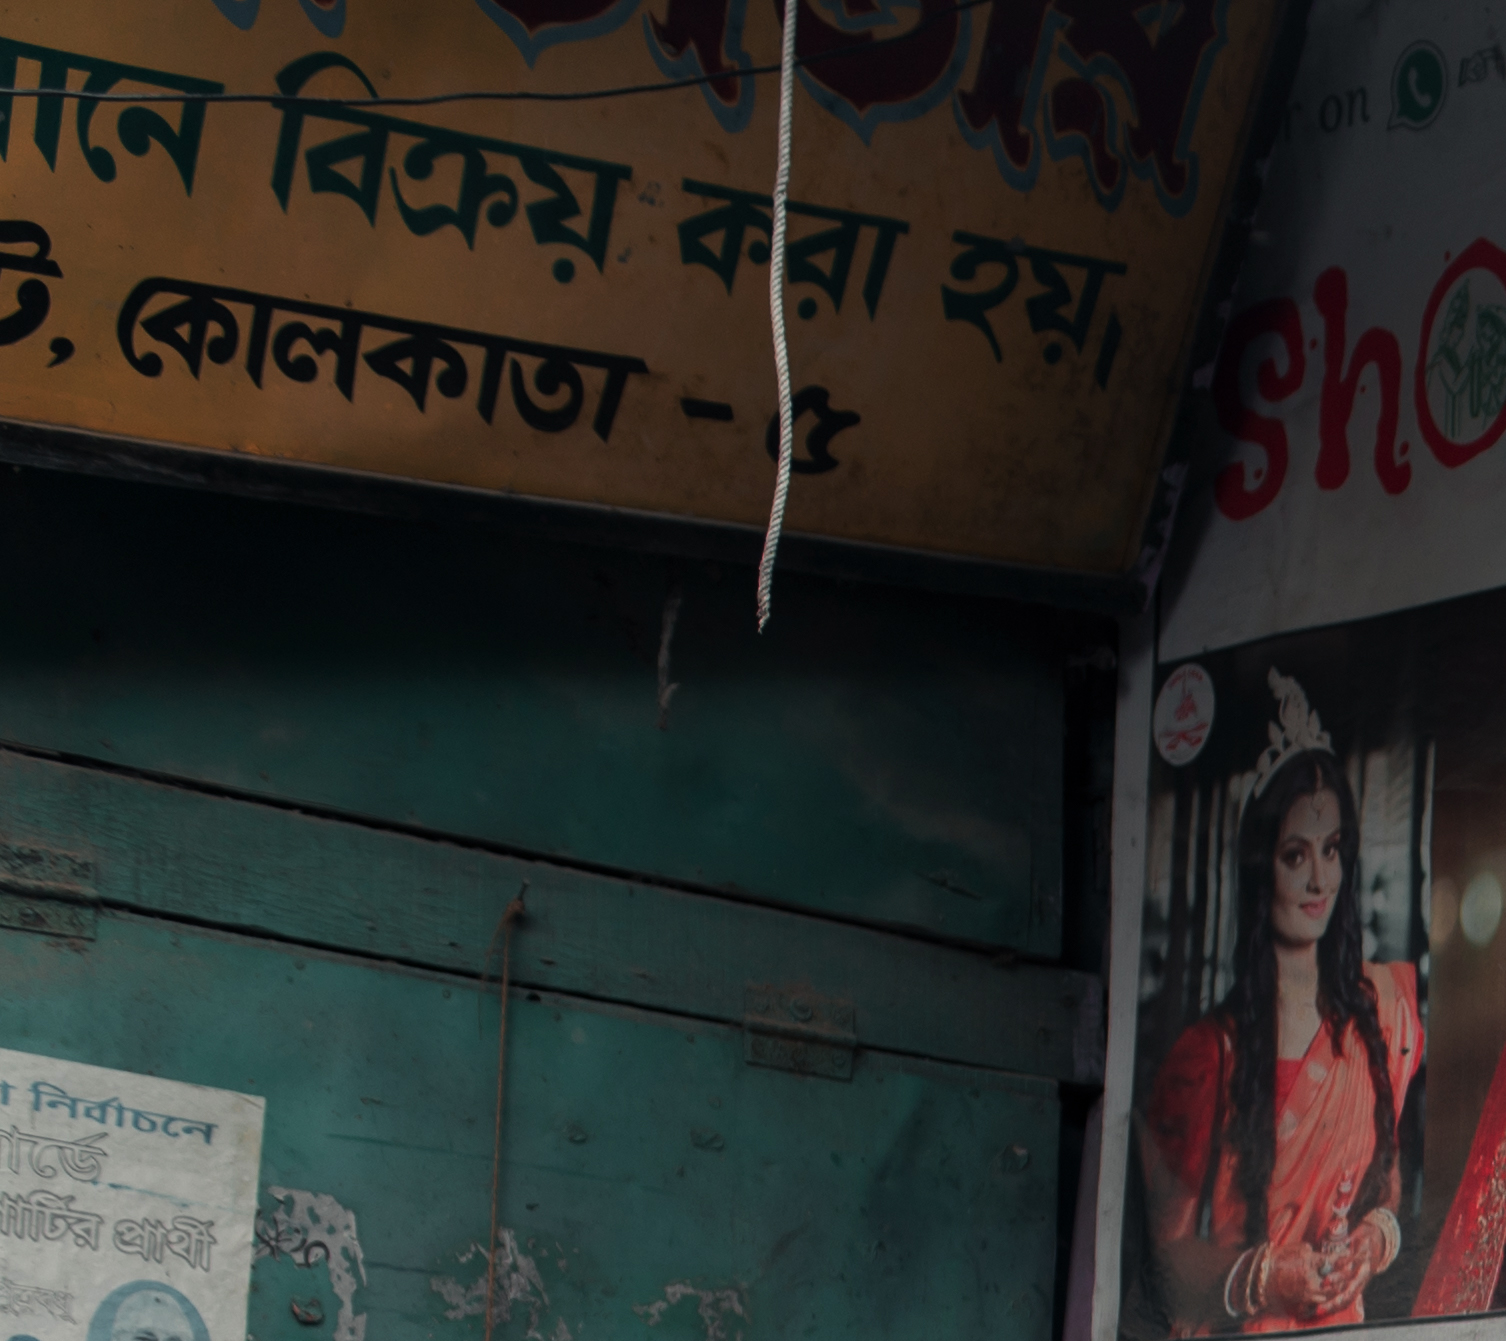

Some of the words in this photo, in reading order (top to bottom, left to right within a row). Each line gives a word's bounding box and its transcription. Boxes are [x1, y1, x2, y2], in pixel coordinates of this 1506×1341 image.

[1318, 86, 1371, 134] on
[0, 36, 225, 198] ানে
[272, 51, 633, 284] বিক্রয়
[677, 178, 910, 322] করা
[117, 277, 650, 443] কোলকাতা
[766, 385, 862, 475] ৫
[27, 1080, 219, 1146] নির্বাচনে
